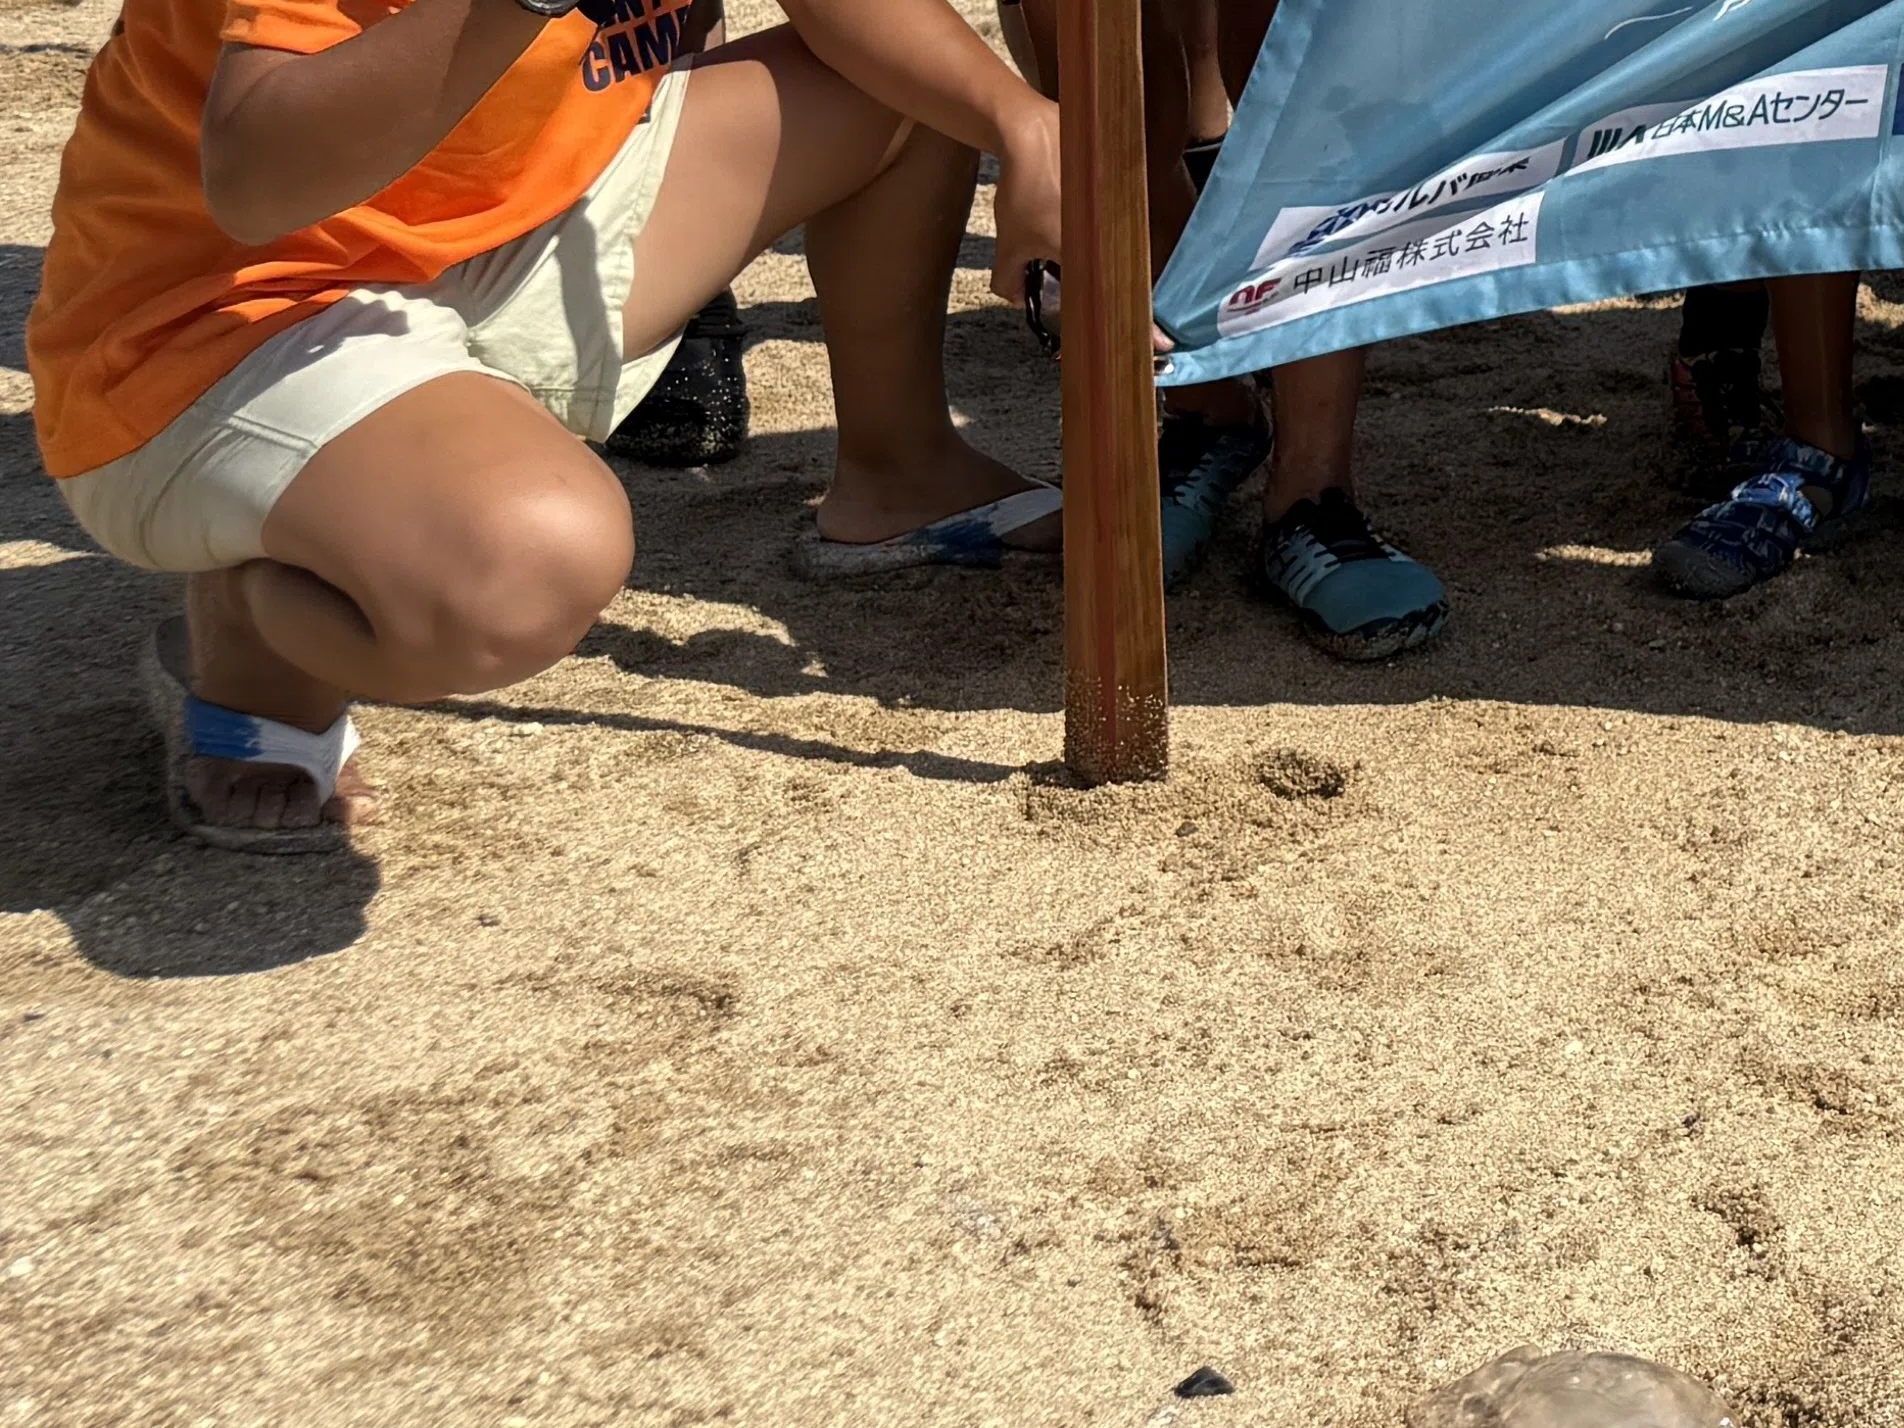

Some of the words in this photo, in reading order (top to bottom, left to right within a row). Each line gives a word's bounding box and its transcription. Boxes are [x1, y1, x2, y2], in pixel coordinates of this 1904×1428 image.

[582, 8, 690, 91] CAM
[1293, 211, 1529, 295] 中山福株式会社
